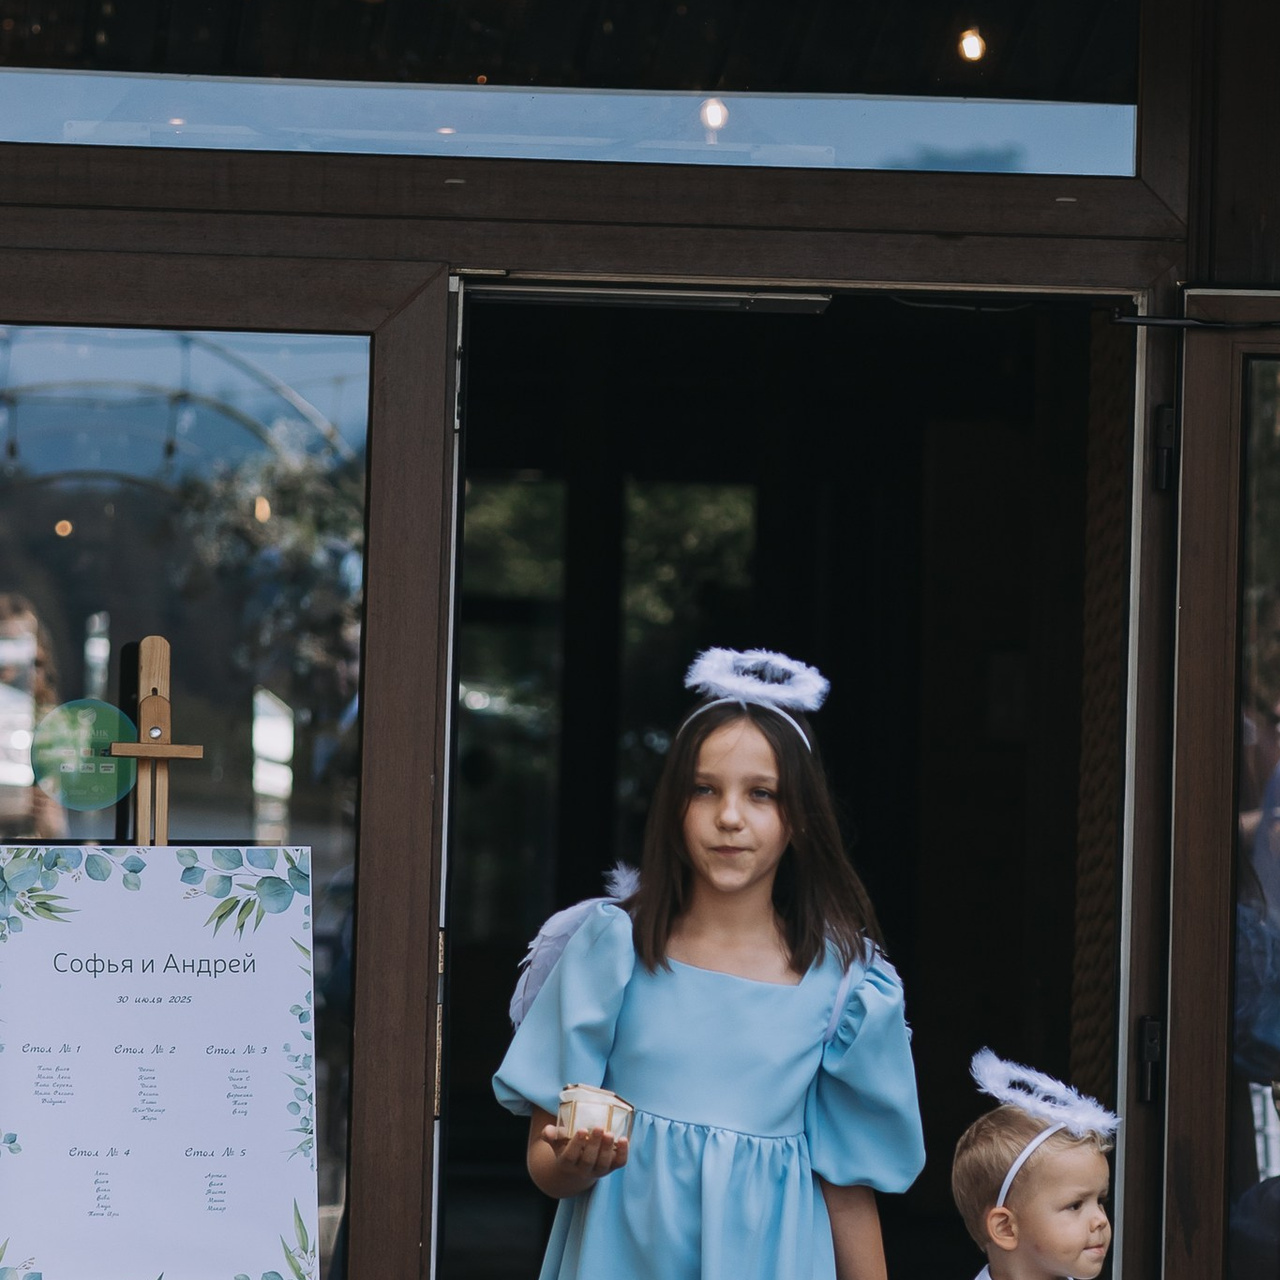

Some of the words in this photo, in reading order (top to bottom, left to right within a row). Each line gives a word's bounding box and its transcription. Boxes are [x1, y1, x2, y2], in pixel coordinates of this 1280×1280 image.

[53, 952, 133, 979] Софья
[141, 958, 155, 974] и
[162, 952, 256, 979] Андрей
[116, 995, 129, 1004] 30
[134, 996, 163, 1004] июля
[168, 995, 193, 1004] 2025
[21, 1042, 52, 1054] Стол
[76, 1045, 81, 1054] 1
[114, 1044, 144, 1055] Стол
[168, 1046, 176, 1054] 2
[205, 1044, 236, 1055] Стол
[260, 1046, 268, 1055] 3
[68, 1146, 99, 1157] Стол
[123, 1149, 131, 1157] 4
[184, 1147, 215, 1158] Стол
[239, 1148, 247, 1157] 5
